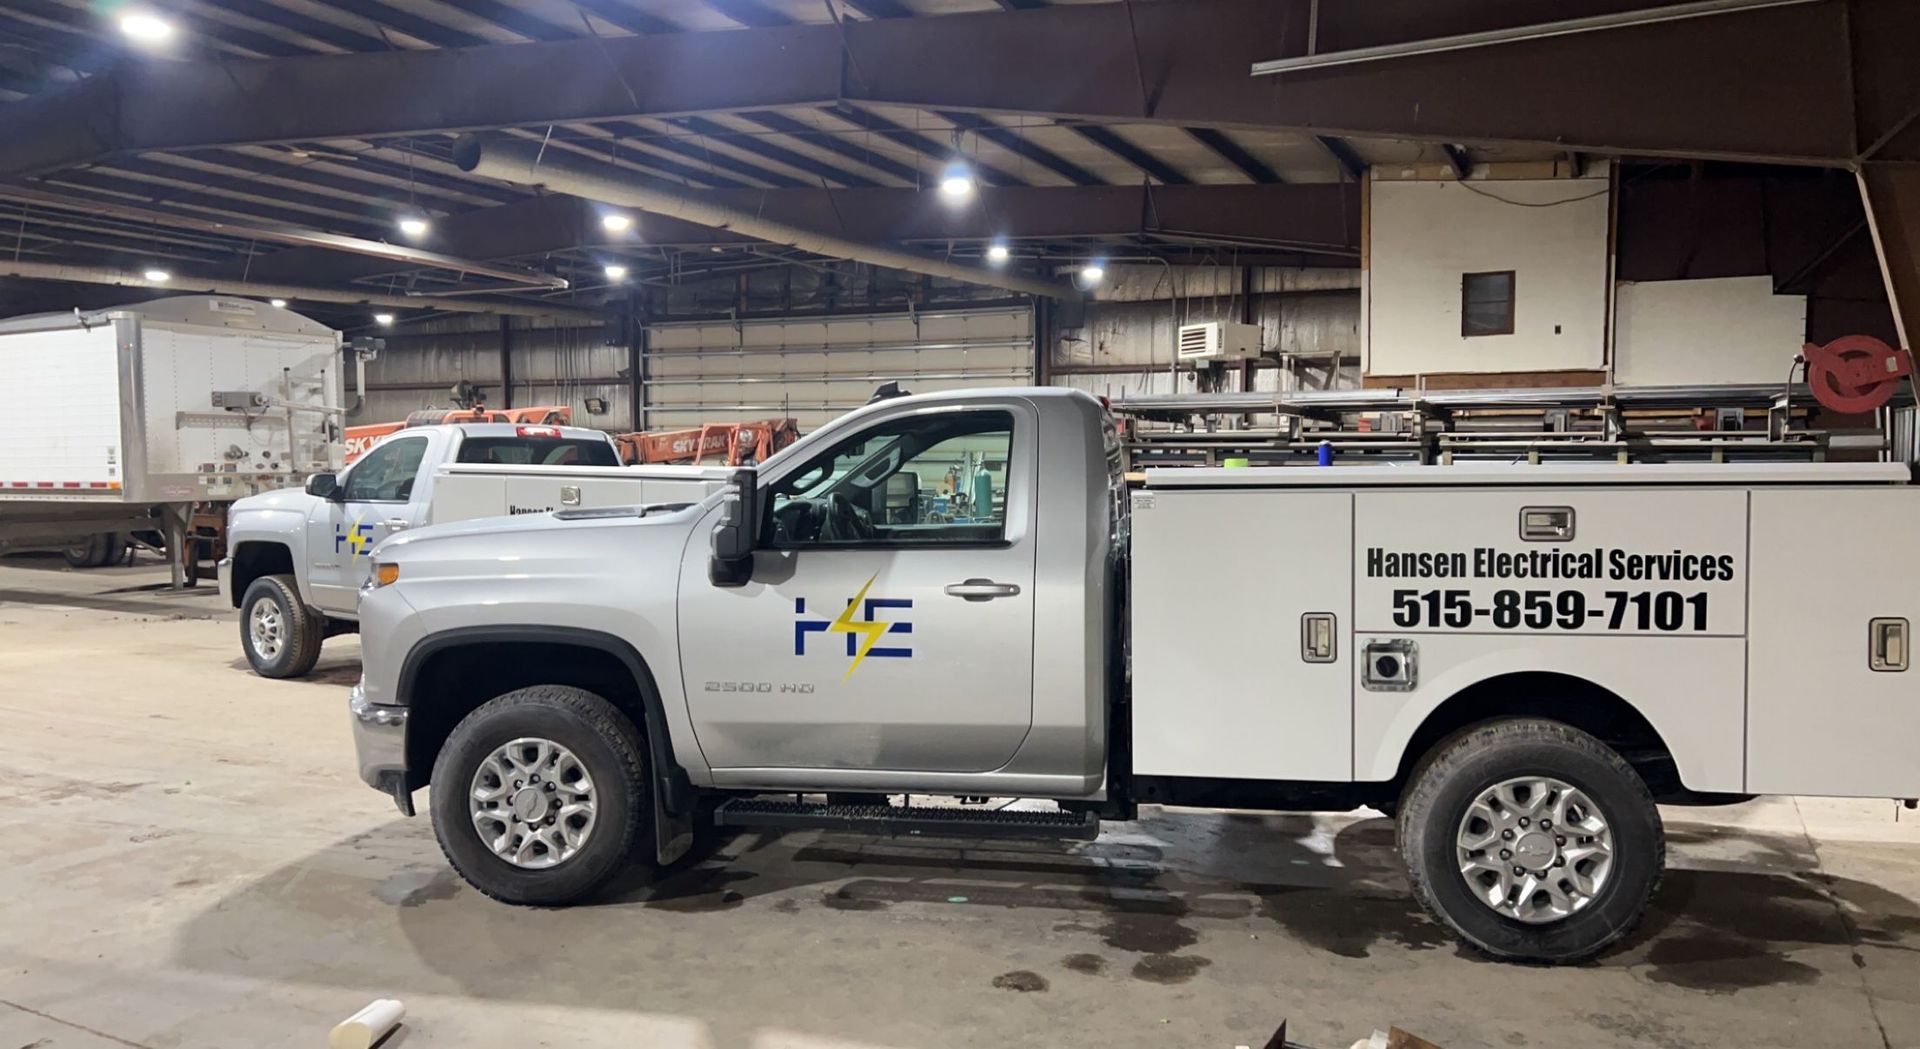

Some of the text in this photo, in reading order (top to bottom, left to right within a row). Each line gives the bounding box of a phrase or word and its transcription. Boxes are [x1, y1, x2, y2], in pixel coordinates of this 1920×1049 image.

[1366, 548, 1734, 581] Hansen Electrical Services
[795, 597, 913, 657] HE
[1392, 589, 1708, 631] 515-859-7101
[704, 681, 815, 694] 2500 HD
